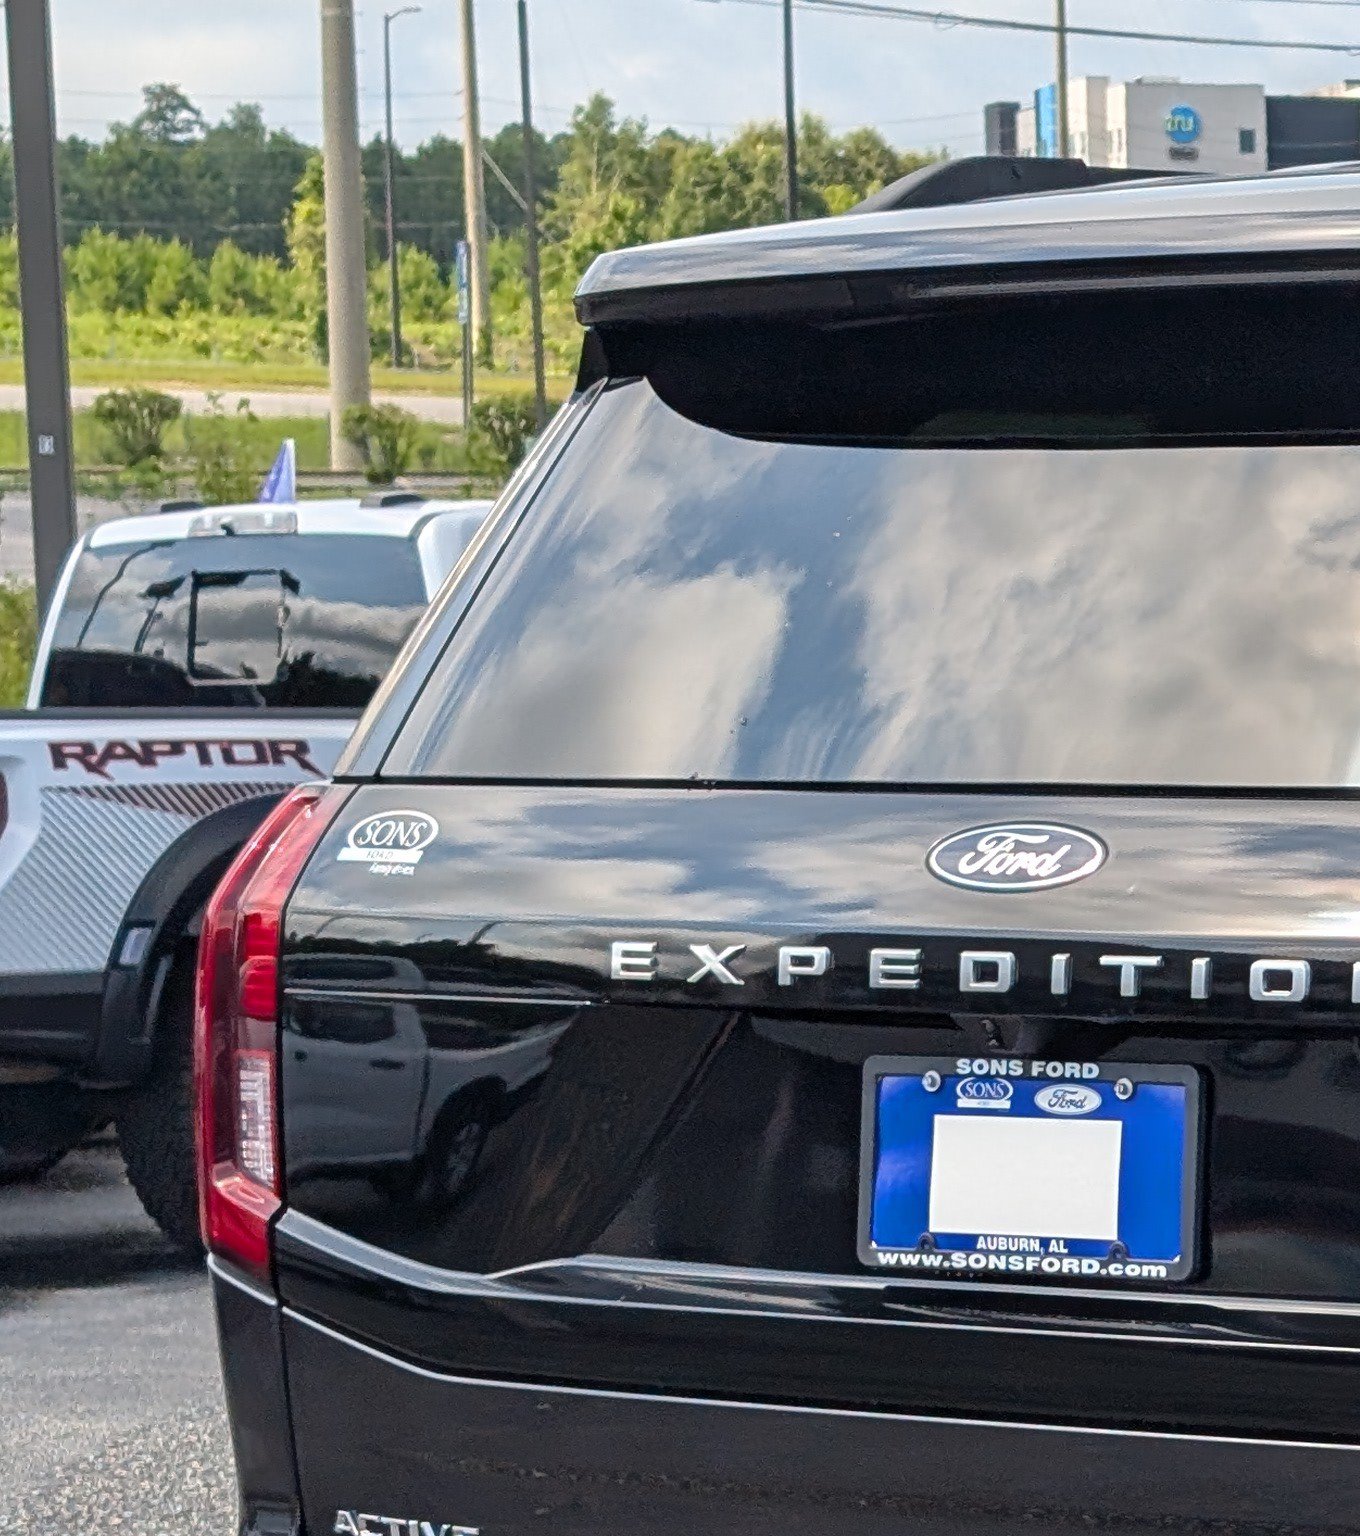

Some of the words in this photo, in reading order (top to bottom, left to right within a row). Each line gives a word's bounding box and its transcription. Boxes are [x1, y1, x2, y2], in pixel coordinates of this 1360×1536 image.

[48, 740, 328, 782] RAPTOR
[357, 820, 428, 847] SONS
[958, 831, 1072, 876] Ford
[956, 1058, 1024, 1076] SONS
[1031, 1060, 1100, 1079] FORD
[965, 1081, 1005, 1098] SONS
[1047, 1089, 1088, 1110] Ford
[976, 1236, 1044, 1254] AUBURN,
[1048, 1239, 1069, 1253] AL
[877, 1252, 1168, 1278] www.SONSFORD.com
